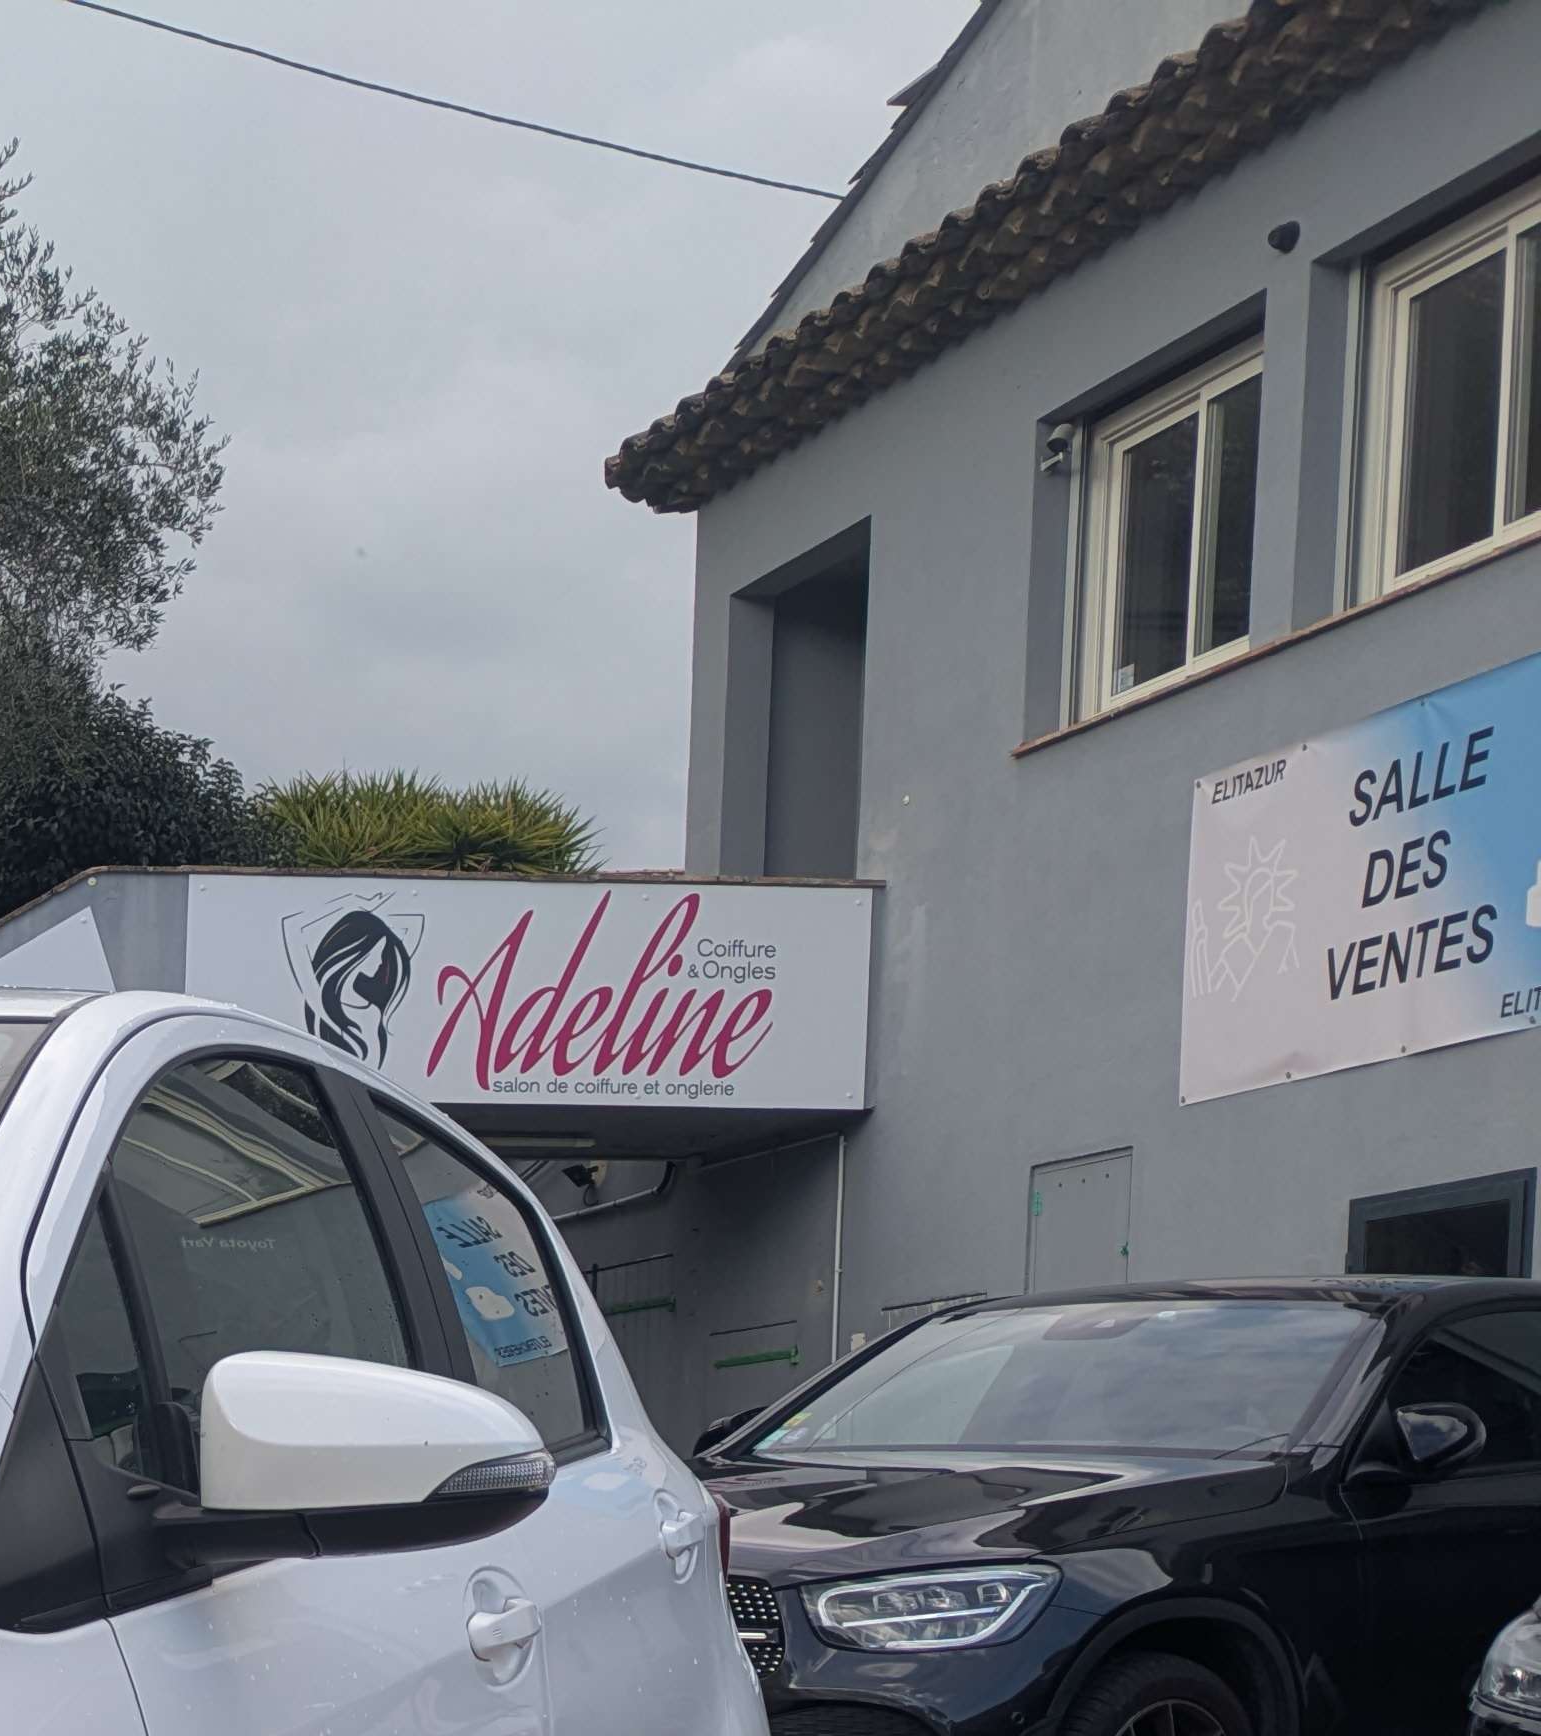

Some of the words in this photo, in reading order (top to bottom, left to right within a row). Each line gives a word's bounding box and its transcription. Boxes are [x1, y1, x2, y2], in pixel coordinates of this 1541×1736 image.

[1211, 759, 1287, 805] ELITAZUR
[1348, 725, 1495, 828] SALLE
[1361, 829, 1452, 909] DES
[697, 938, 777, 959] Coiffure
[1326, 904, 1498, 1001] VENTES
[426, 889, 774, 1091] Adeline
[492, 1077, 541, 1094] salon
[546, 1078, 568, 1095] de
[574, 1078, 638, 1096] coiffure
[643, 1079, 660, 1096] et
[665, 1080, 735, 1100] onglerie
